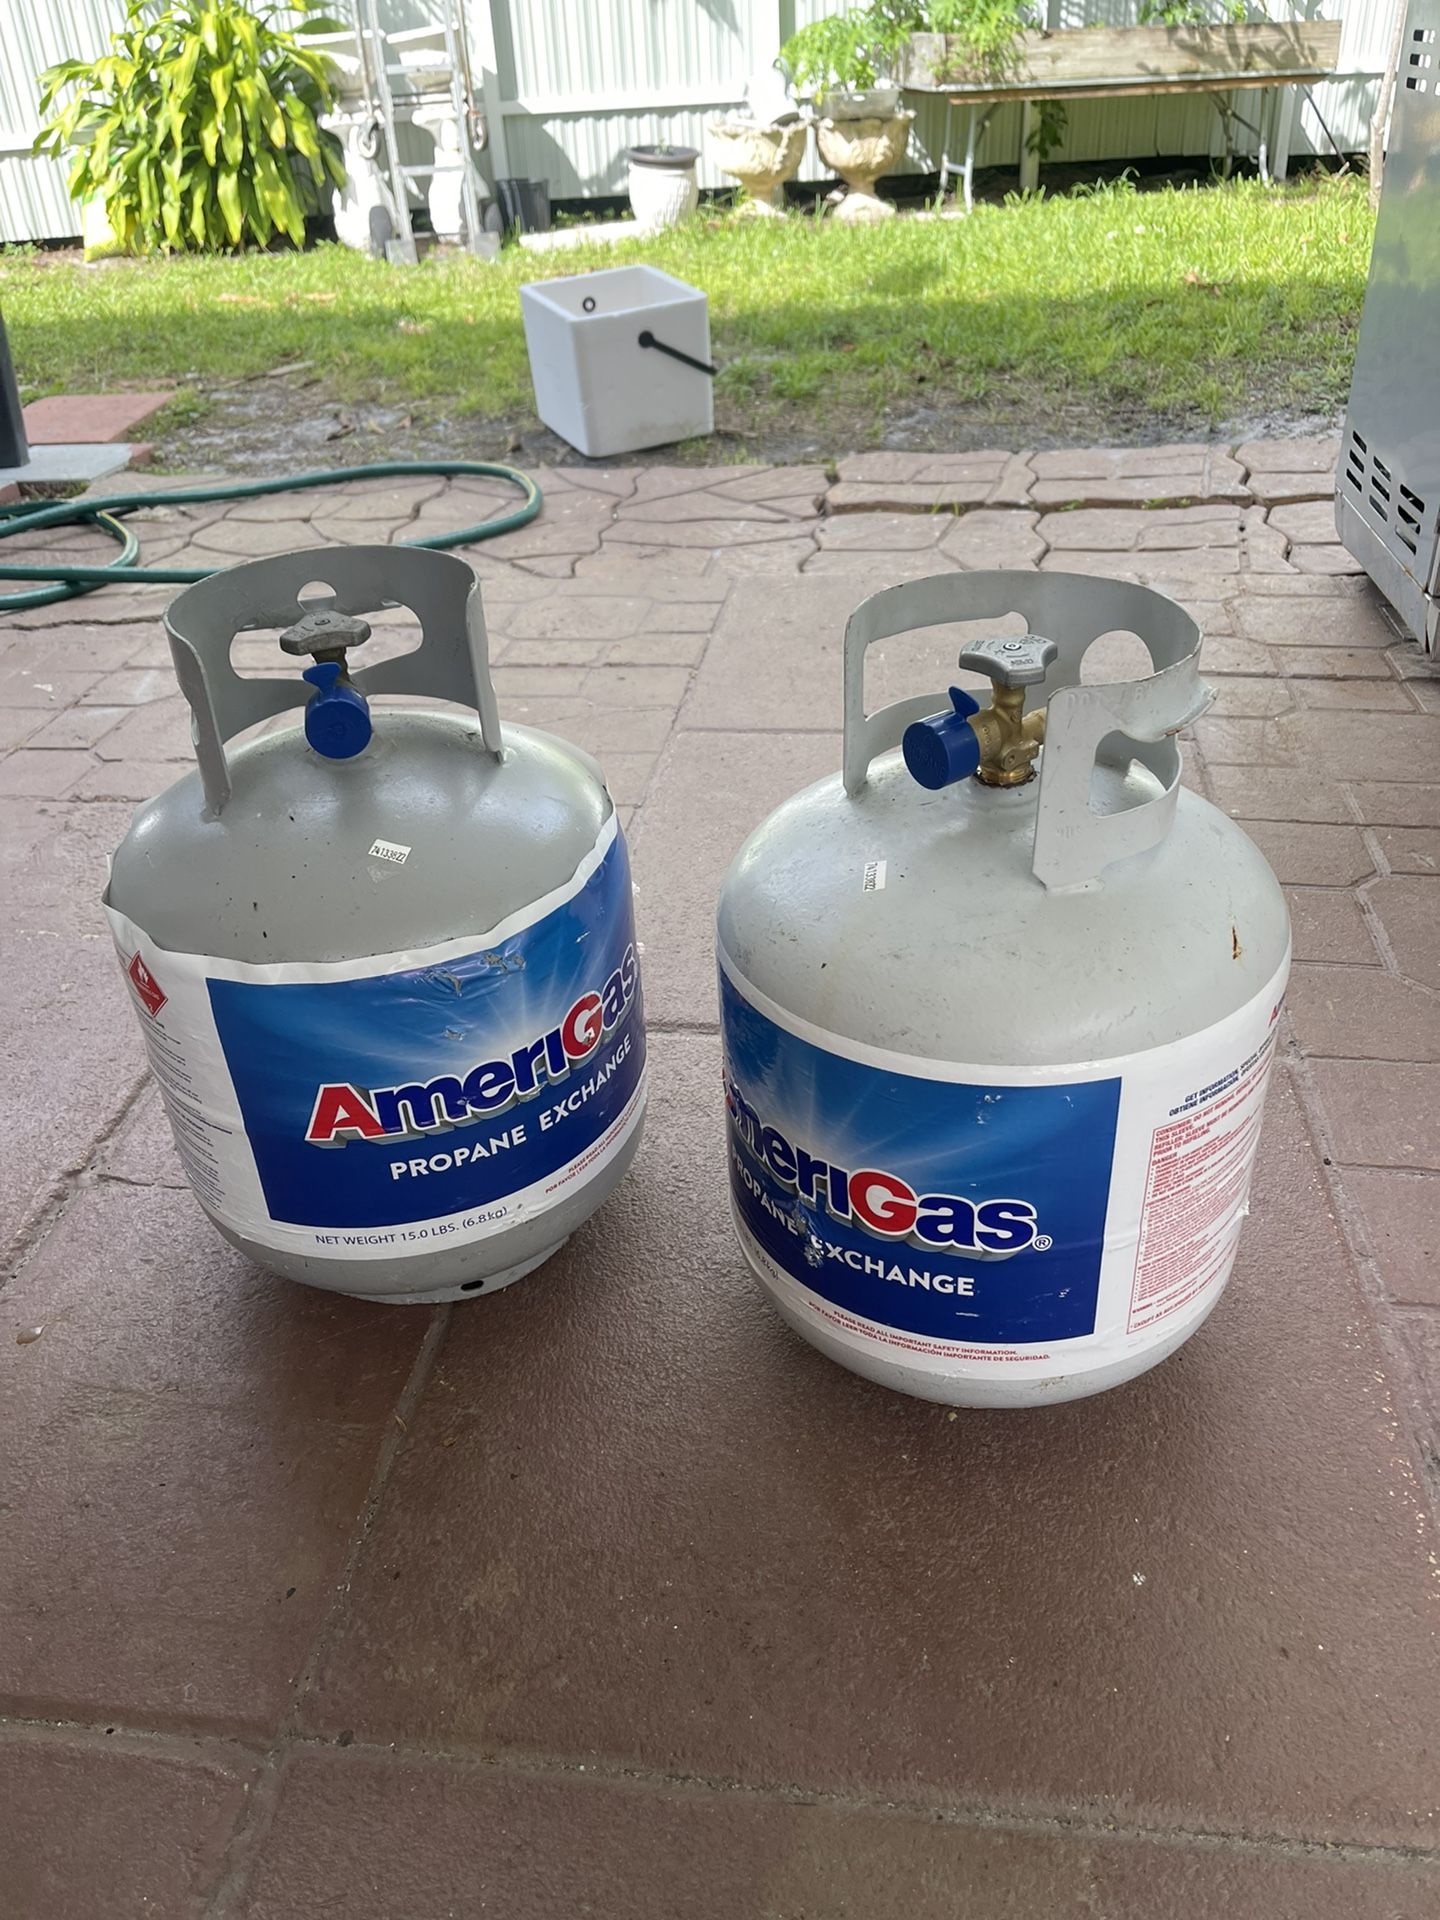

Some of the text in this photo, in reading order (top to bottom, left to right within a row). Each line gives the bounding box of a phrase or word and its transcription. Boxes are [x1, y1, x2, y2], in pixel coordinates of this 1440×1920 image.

[304, 943, 637, 1146] AmeriGas
[538, 1033, 632, 1132] EXCHANGE
[389, 1124, 528, 1181] PROPANE
[315, 1233, 341, 1245] NET
[342, 1233, 396, 1246] WEIGHT
[400, 1228, 428, 1242] 15.0
[431, 1222, 460, 1237] LBS.
[810, 1234, 975, 1297] EXCHANGE
[821, 1309, 842, 1324] FAVOR
[842, 1320, 858, 1331] LEER
[859, 1329, 878, 1340] TODA
[878, 1335, 888, 1343] LA
[943, 1351, 991, 1362] IMPORTANTE
[833, 1310, 856, 1325] PLEASE
[857, 1322, 876, 1333] READ
[876, 1329, 889, 1337] ALL
[889, 1333, 932, 1348] IMPORTANT
[933, 1344, 960, 1353] SAFETY
